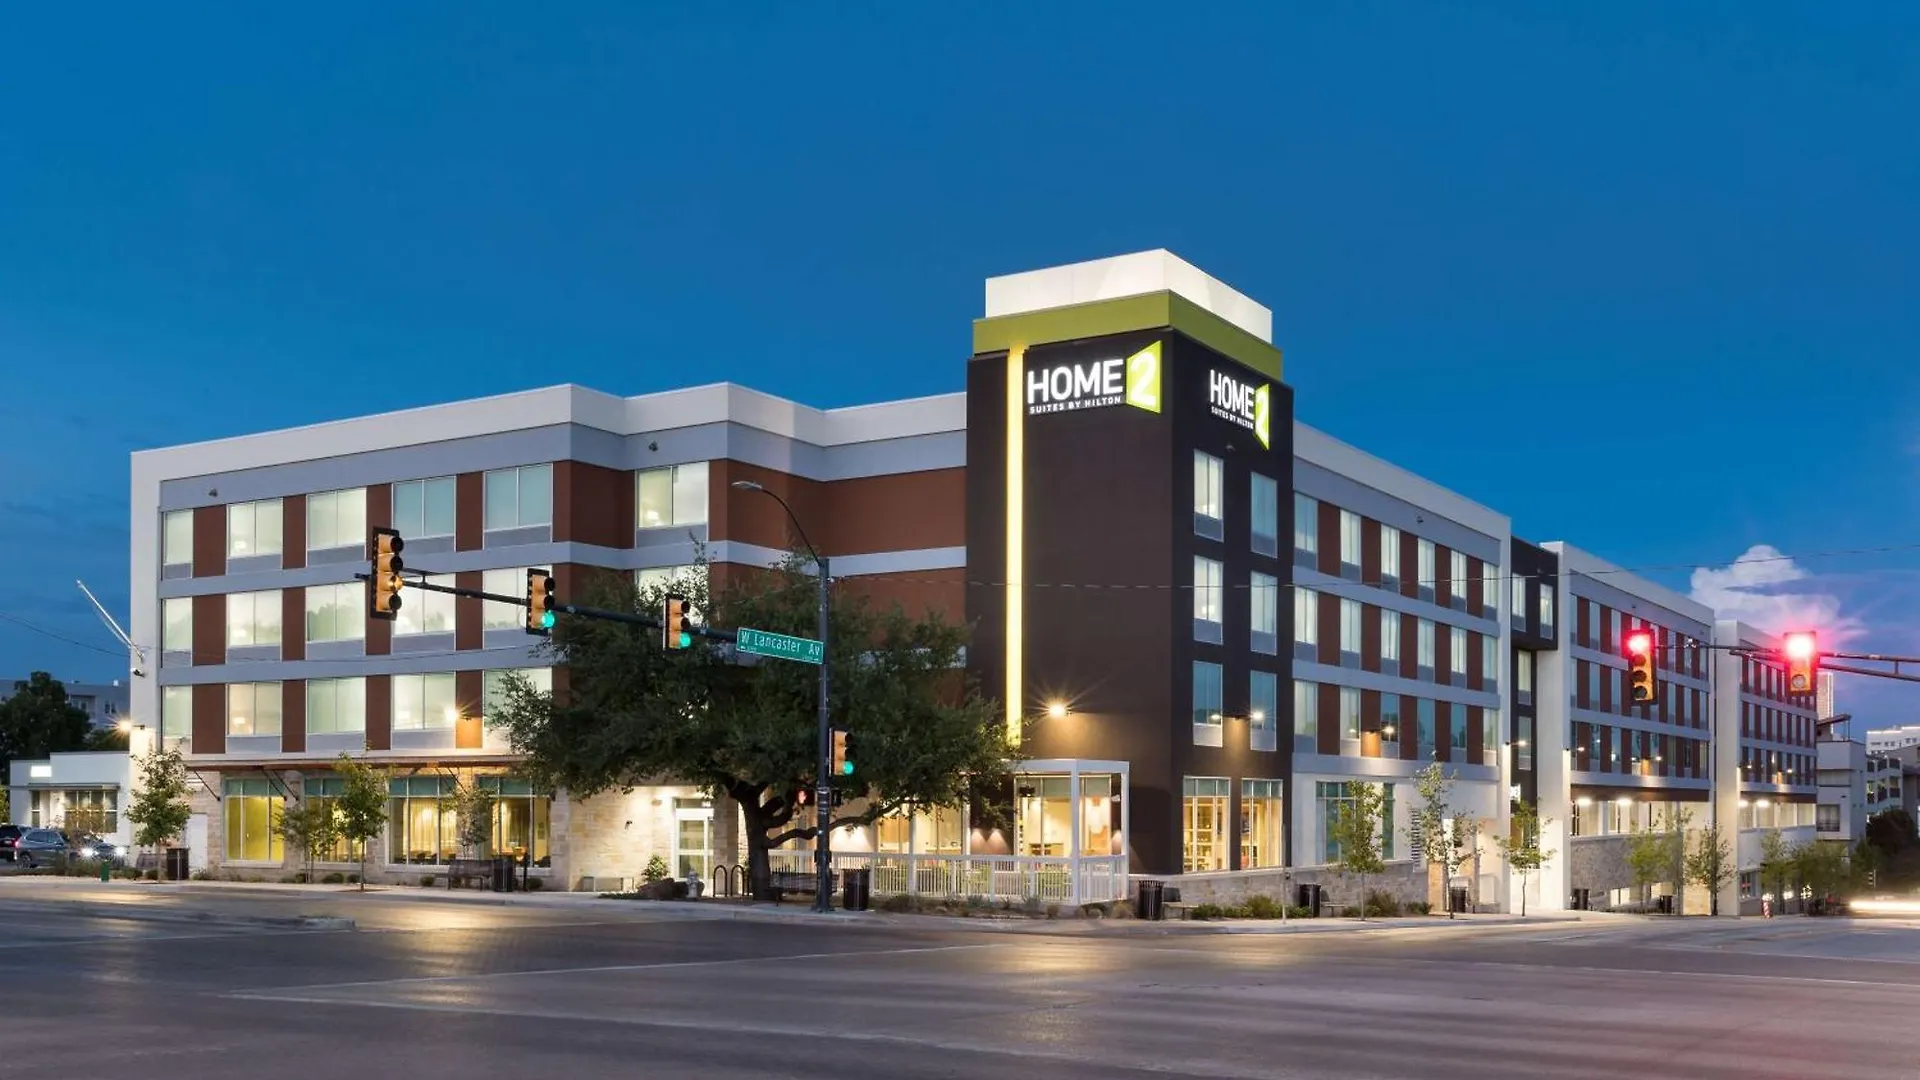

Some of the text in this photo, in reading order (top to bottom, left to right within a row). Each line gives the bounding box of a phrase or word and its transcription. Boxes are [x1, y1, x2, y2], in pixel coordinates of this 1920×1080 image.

[1029, 396, 1121, 414] SUITES BY HILTON
[741, 631, 750, 644] W
[754, 634, 801, 653] Lancaster
[808, 643, 820, 656] Av
